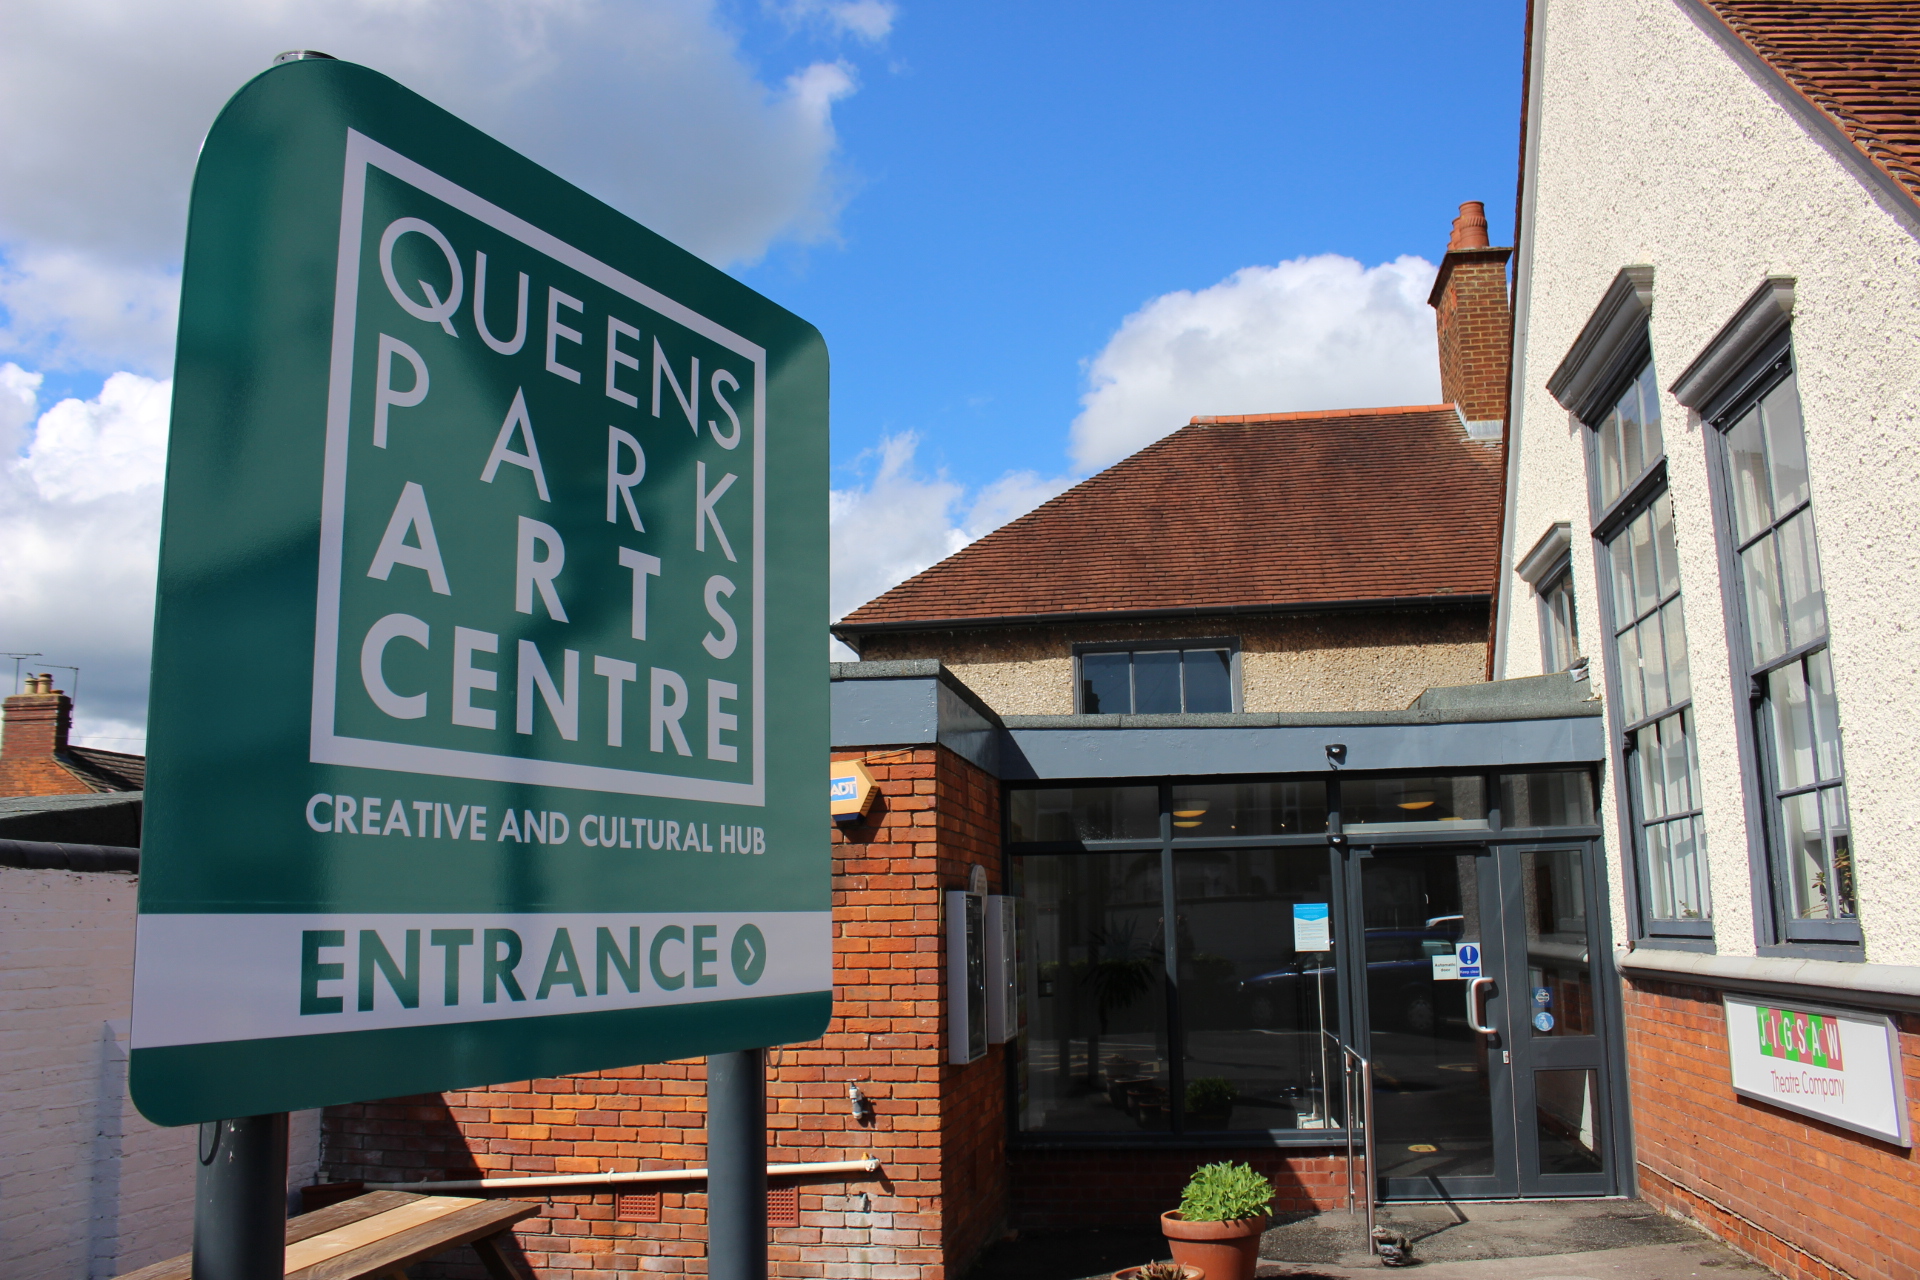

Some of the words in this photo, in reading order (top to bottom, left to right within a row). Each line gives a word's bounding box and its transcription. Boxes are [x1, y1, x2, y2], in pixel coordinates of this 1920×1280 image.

[380, 218, 740, 449] QUEENS
[374, 333, 737, 562] PARK
[367, 482, 737, 659] ARTS
[361, 614, 737, 762] CENTRE
[306, 793, 486, 841] CREATIVE
[498, 808, 569, 845] AND
[579, 814, 713, 853] CULTURAL
[721, 825, 766, 855] HUB
[831, 782, 857, 797] ADT
[300, 924, 718, 1016] ENTRANCE
[1760, 1013, 1839, 1060] JIGSAW
[1771, 1069, 1800, 1094] Theatre
[1802, 1071, 1844, 1104] Company
